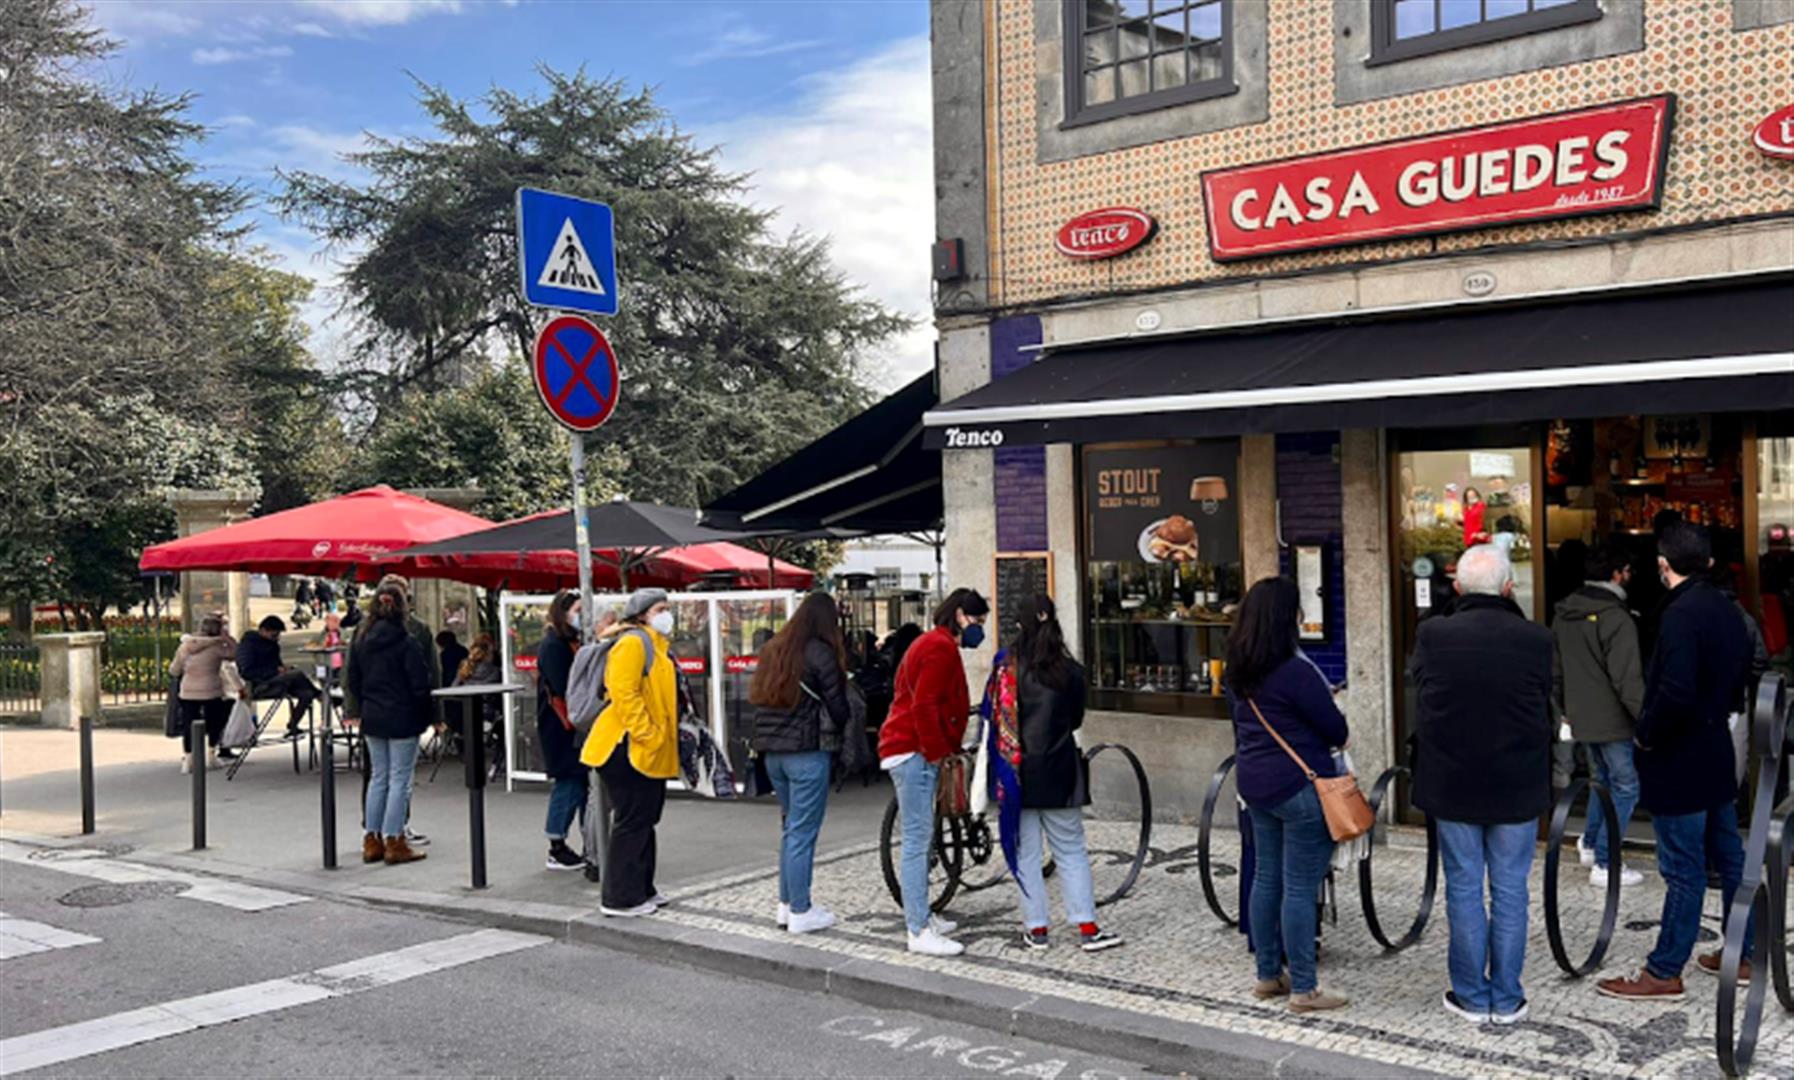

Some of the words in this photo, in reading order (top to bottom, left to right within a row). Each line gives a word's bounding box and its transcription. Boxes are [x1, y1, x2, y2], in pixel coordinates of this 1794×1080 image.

[1231, 169, 1381, 230] CASA
[1397, 129, 1631, 207] GUEDES
[945, 427, 1004, 447] Tenco
[1098, 469, 1161, 495] STOUT
